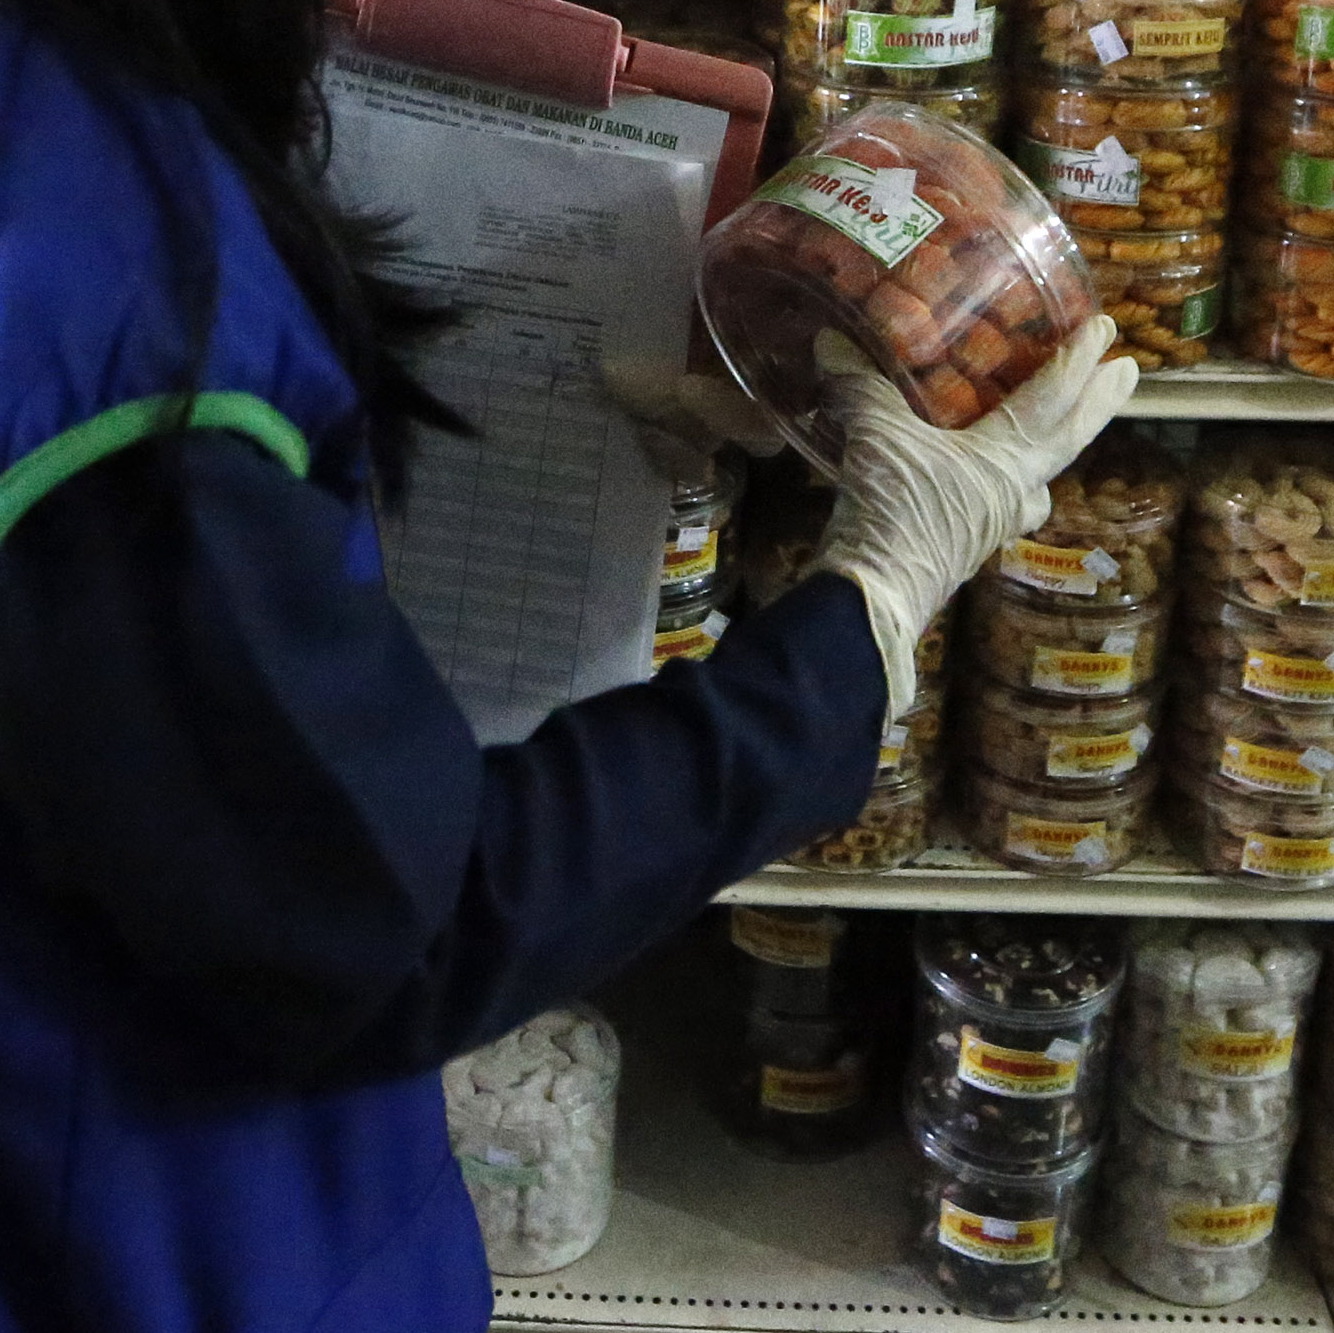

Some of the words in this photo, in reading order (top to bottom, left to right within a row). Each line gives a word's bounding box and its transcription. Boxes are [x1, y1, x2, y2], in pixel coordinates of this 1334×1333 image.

[589, 115, 605, 134] DI
[605, 118, 644, 143] BANDA
[645, 127, 679, 151] ACEH
